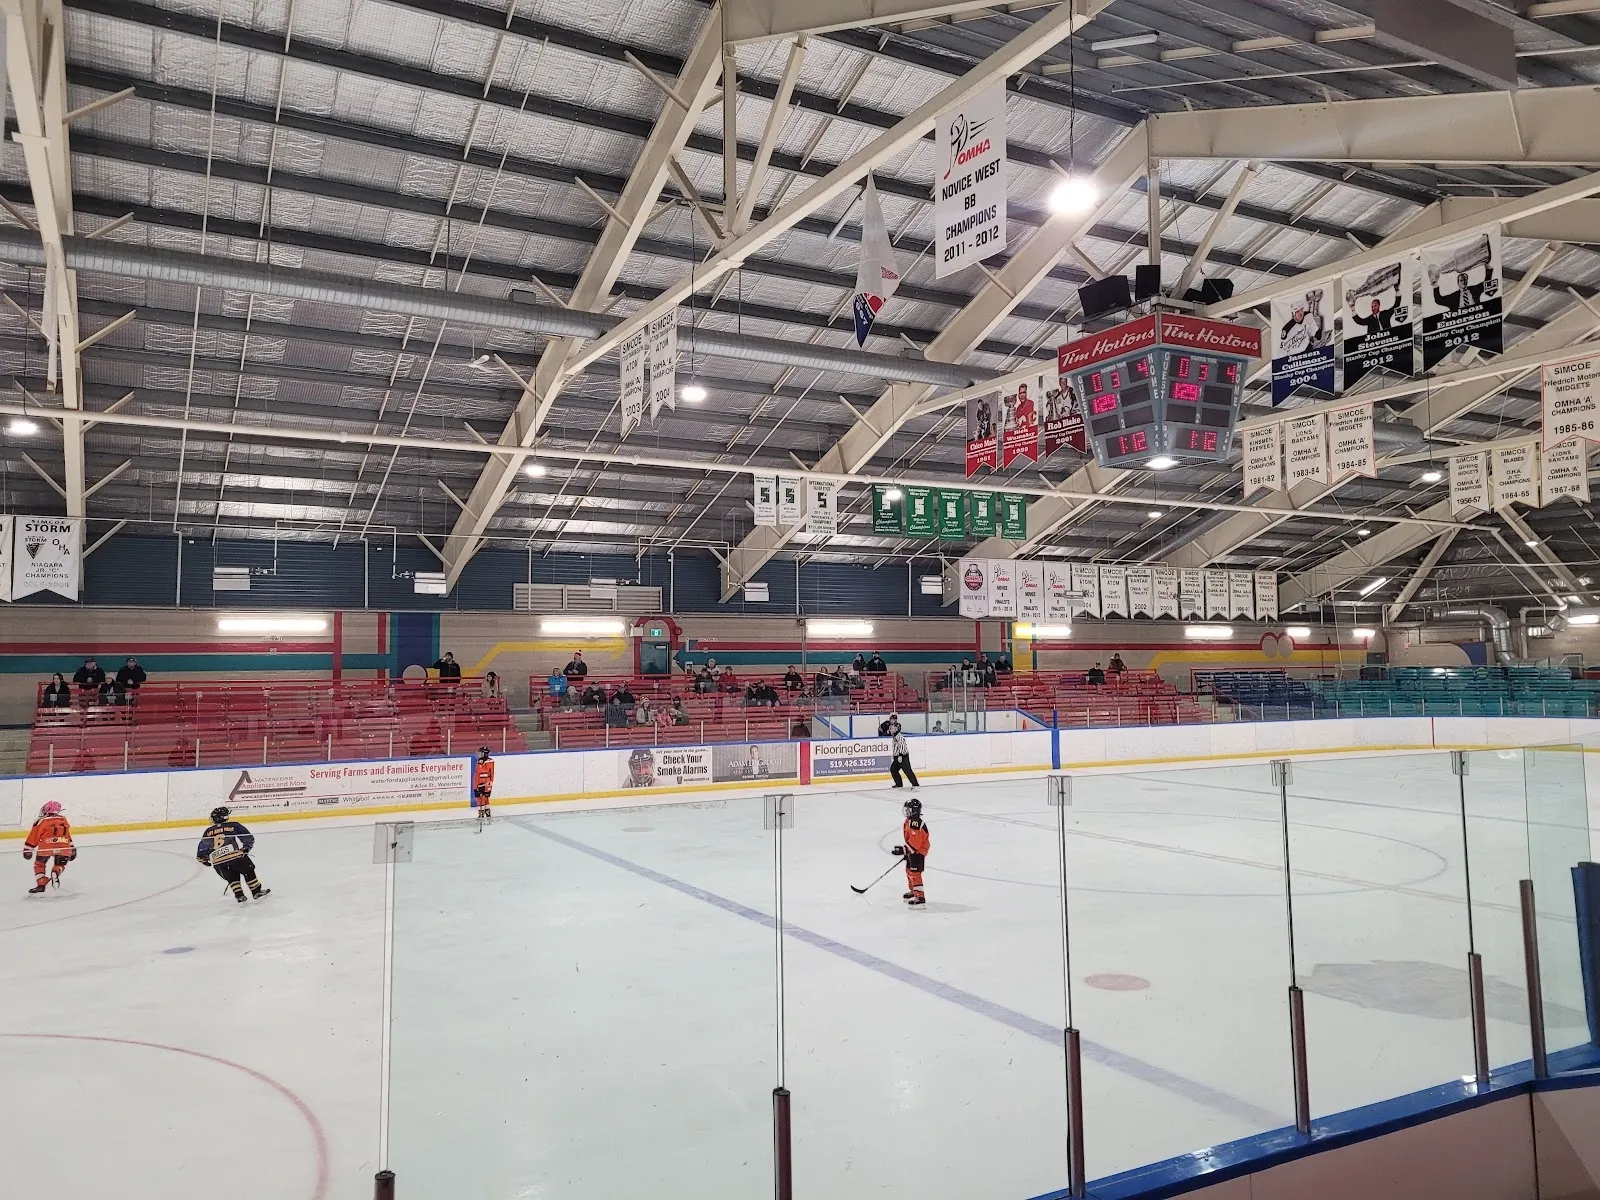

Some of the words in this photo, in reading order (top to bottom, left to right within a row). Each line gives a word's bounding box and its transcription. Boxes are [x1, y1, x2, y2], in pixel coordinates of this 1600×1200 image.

[957, 138, 991, 165] OMHA
[942, 173, 972, 201] NOVICE
[975, 158, 1001, 182] WEST
[964, 193, 976, 211] BB
[945, 204, 997, 241] CHAMPIONS
[944, 241, 965, 262] 2011
[975, 225, 999, 248] 2012
[1442, 304, 1484, 320] Nelson
[652, 312, 675, 334] SIMCOE
[1437, 310, 1490, 329] Emerson
[1364, 330, 1391, 342] John
[1425, 331, 1449, 342] Stanley
[1450, 326, 1465, 335] Cup
[1466, 318, 1501, 331] Champion
[1163, 323, 1195, 341] Tim
[1196, 327, 1259, 350] Hortons
[1357, 335, 1399, 350] Stevens
[1444, 332, 1480, 348] 2012
[622, 333, 642, 354] SIMCOE
[656, 336, 669, 353] ATOM
[1061, 348, 1089, 367] Tim
[1092, 328, 1155, 357] Hortons
[1287, 350, 1320, 363] Jassen
[1345, 353, 1367, 363] Stanley
[1381, 341, 1413, 354] Champion
[1281, 356, 1327, 370] Cullimore
[1362, 354, 1394, 368] 2012
[1273, 373, 1294, 381] Stanley
[1306, 362, 1334, 373] Champion
[1554, 361, 1591, 375] SIMCOE
[1147, 353, 1159, 399] HOME
[1160, 352, 1170, 399] GUEST
[1289, 373, 1318, 387] 2004
[1233, 362, 1242, 406] HOME
[1555, 381, 1591, 392] MIDGETS
[656, 388, 670, 402] 2004
[1078, 375, 1088, 419] GUEST
[1554, 398, 1581, 408] OMHA
[625, 402, 641, 417] 2003
[1337, 408, 1364, 420] SIMCOE
[1551, 403, 1596, 416] CHAMPIONS
[1047, 420, 1062, 430] Rob
[1062, 416, 1081, 427] Blake
[1291, 419, 1316, 429] SIMCOE
[1329, 419, 1353, 428] Friedrich
[1353, 415, 1372, 424] Motors
[1338, 422, 1363, 432] MIDGETS
[1250, 428, 1273, 438] SIMCOE
[1295, 429, 1313, 437] LIONS
[1554, 421, 1594, 435] 1985-86
[1055, 435, 1073, 444] 2001
[1249, 437, 1274, 446] KINSMEN
[1291, 434, 1320, 444] BANTAMS
[1338, 439, 1357, 448] OMHA
[1292, 448, 1312, 457] OMHA
[1334, 443, 1369, 454] CHAMPIONS
[1500, 448, 1526, 457] SIMCOE
[1552, 449, 1572, 457] LIONS
[1250, 457, 1268, 465] OMHA
[1290, 453, 1321, 463] CHAMPIONS
[1455, 455, 1479, 464] SIMCOE
[1548, 454, 1579, 463] BANTAMS
[1247, 461, 1276, 470] CHAMPIONS
[1337, 459, 1367, 470] 1984-85
[1547, 472, 1582, 480] CHAMPIONS
[1550, 467, 1570, 475] OMHA
[1498, 478, 1531, 486] CHAMPIONS
[1456, 496, 1482, 505] 1956-57
[1501, 490, 1530, 500] 1964-65
[25, 523, 71, 533] STORM
[815, 742, 889, 755] FlooringCanada
[663, 754, 685, 765] Check
[686, 754, 703, 763] Your
[728, 760, 748, 768] ADAM
[830, 758, 876, 768] 519.426.3255
[310, 768, 341, 780] Serving
[343, 767, 368, 777] Farms
[370, 765, 385, 775] and
[387, 764, 419, 775] Families
[421, 762, 464, 773] Everywhere
[657, 766, 682, 776] Smoke
[683, 765, 708, 775] Alarms
[241, 781, 274, 789] Appliances
[370, 775, 463, 785] waterfordappliances@gmail.com
[343, 795, 370, 803] Whirlpool
